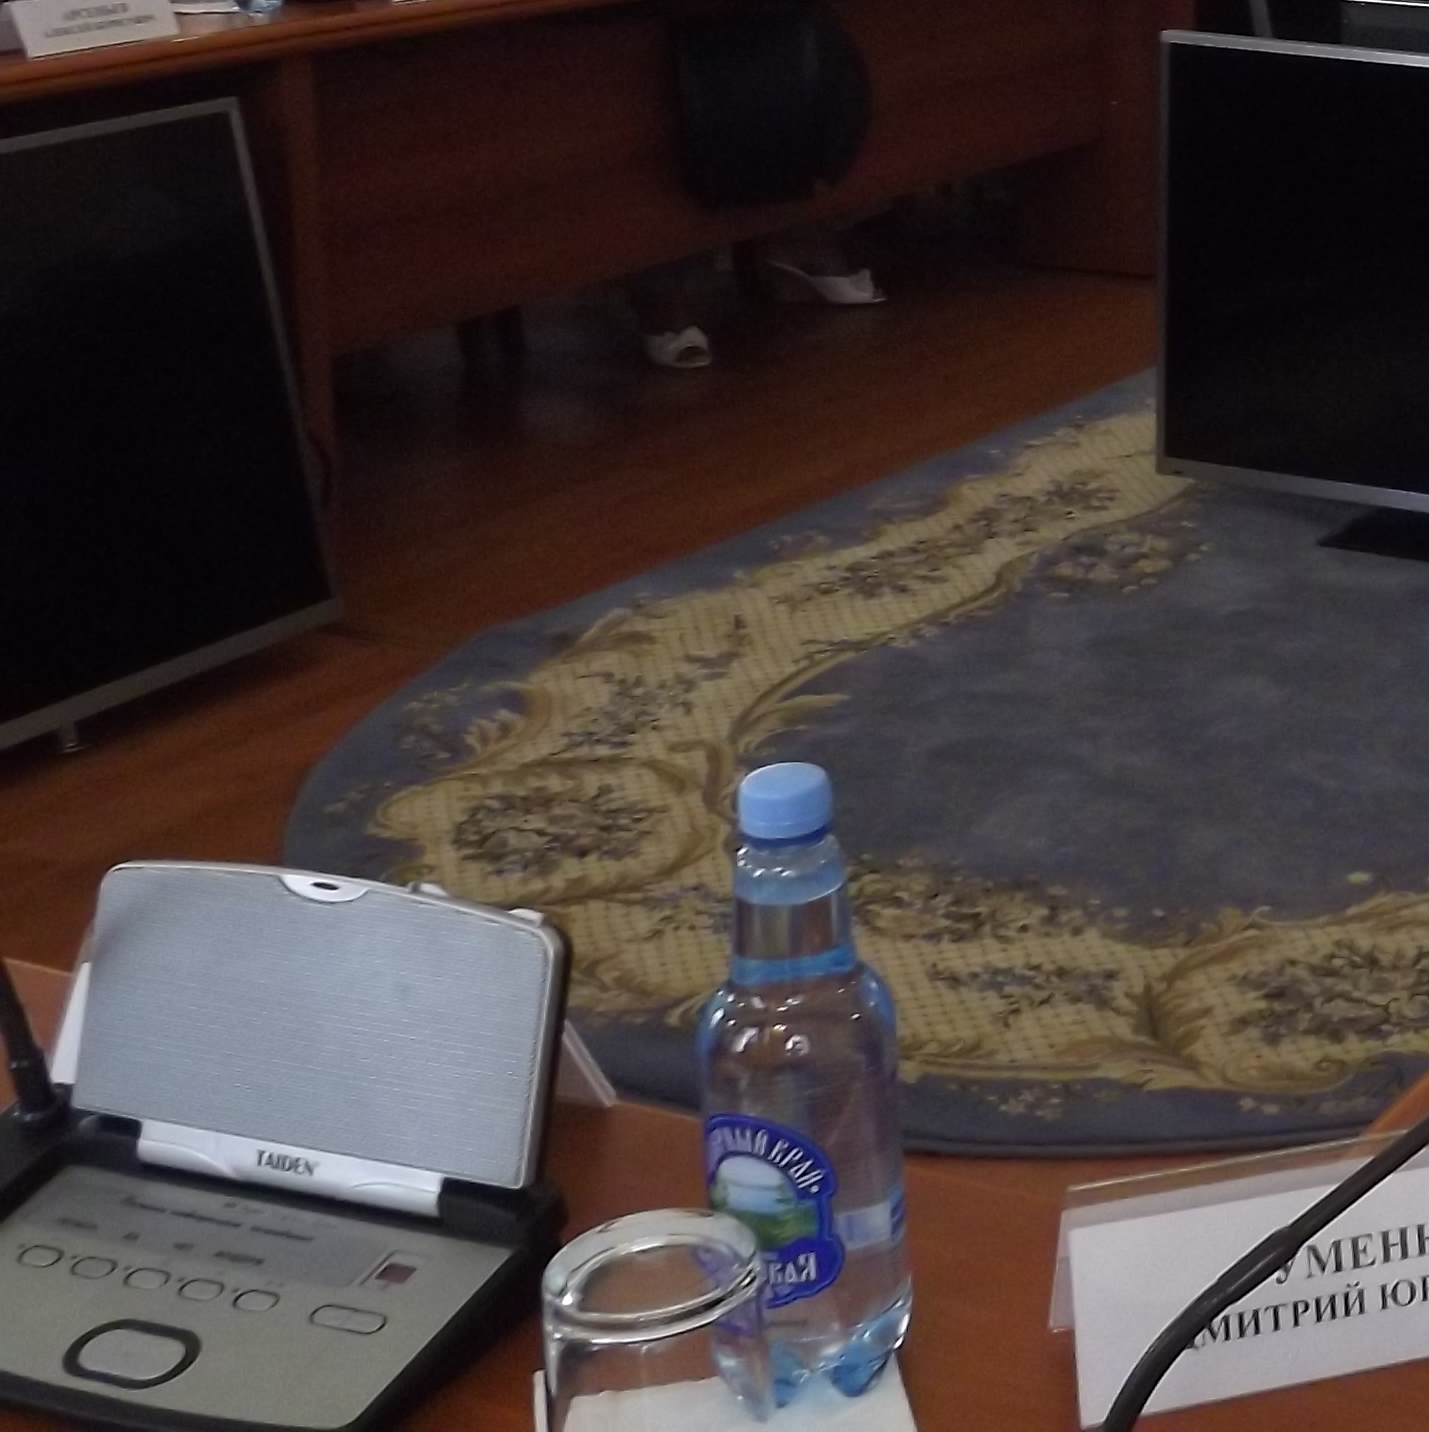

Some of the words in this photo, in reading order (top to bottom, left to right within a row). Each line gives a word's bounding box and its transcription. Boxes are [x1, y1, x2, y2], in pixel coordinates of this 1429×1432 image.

[256, 1148, 315, 1177] TAIDEN
[768, 1138, 825, 1189] КРАЙ
[1184, 1279, 1367, 1351] МИТРИЙ
